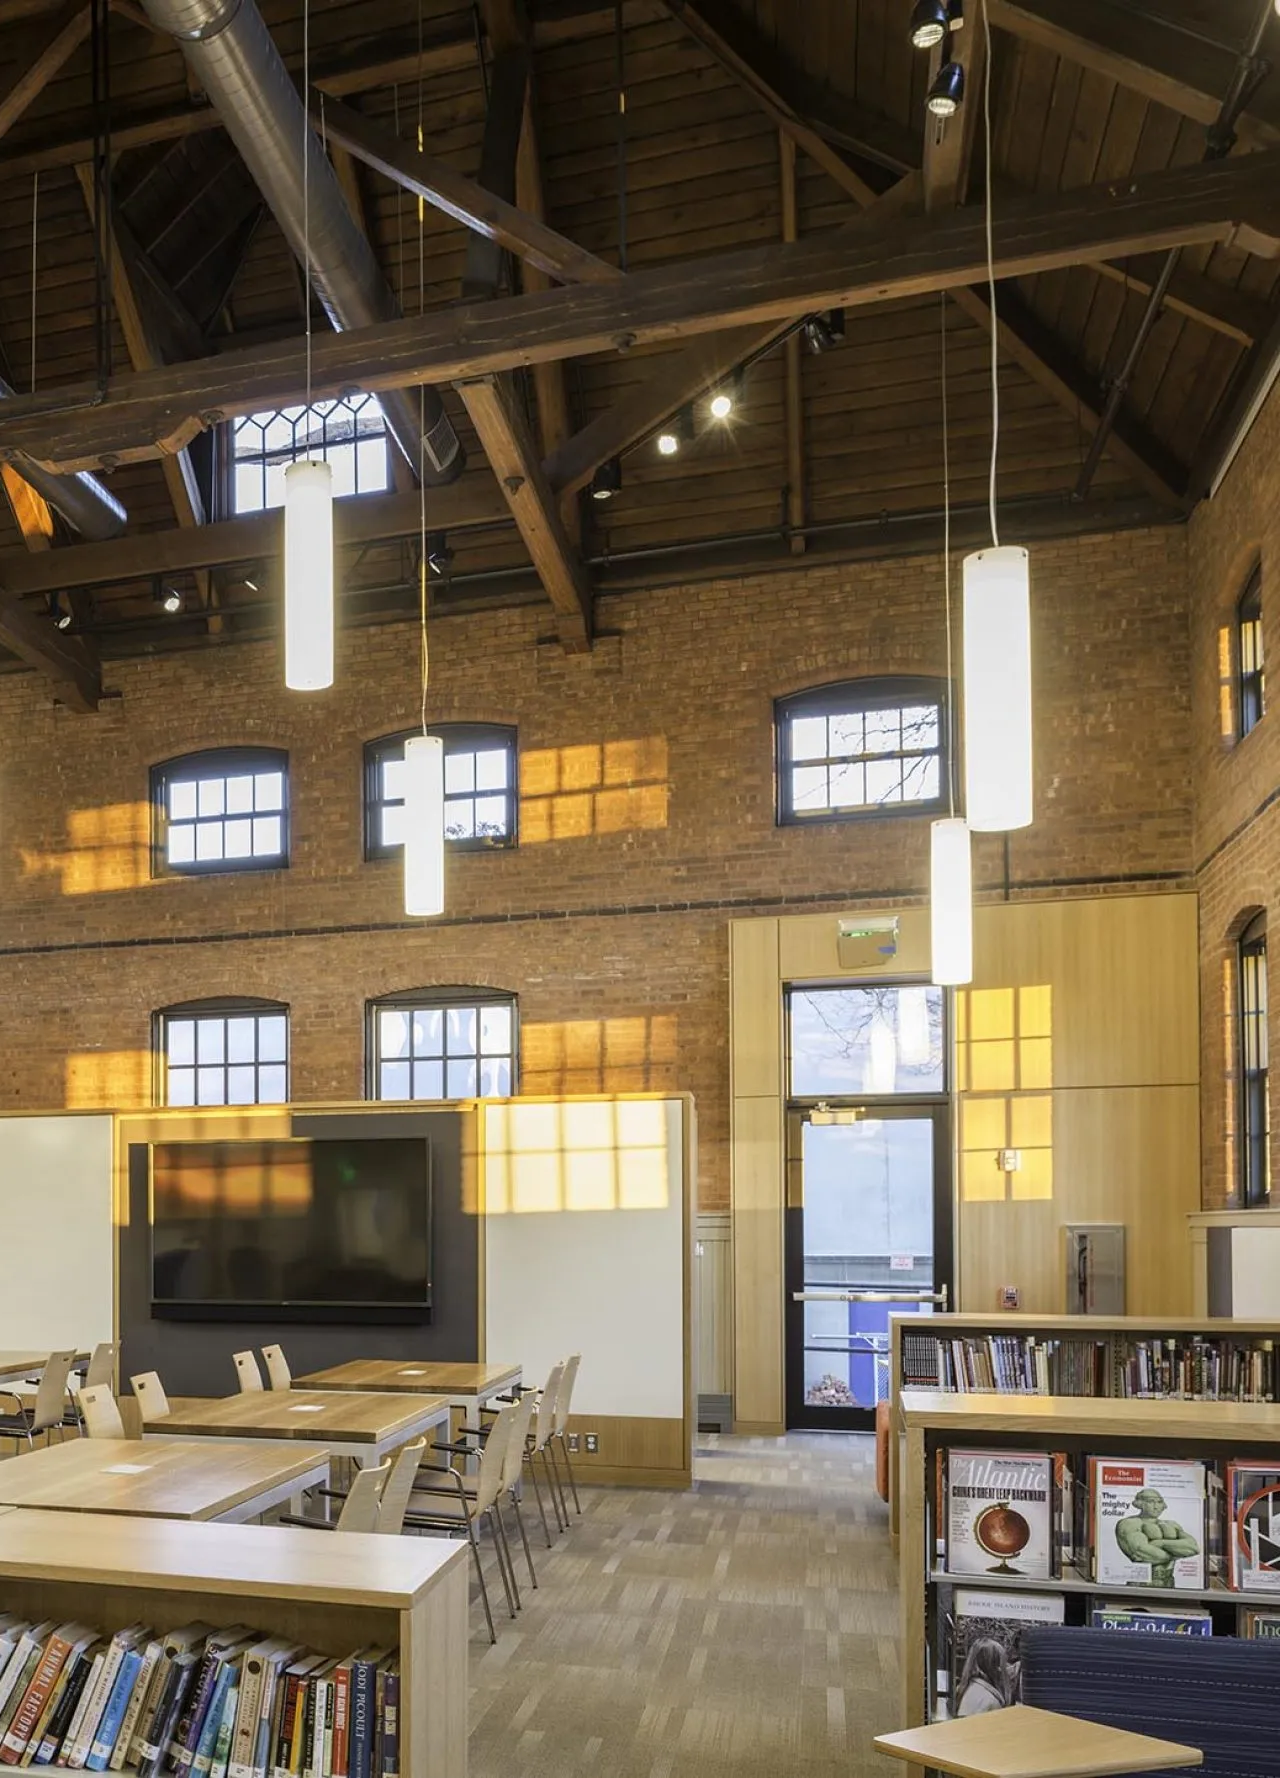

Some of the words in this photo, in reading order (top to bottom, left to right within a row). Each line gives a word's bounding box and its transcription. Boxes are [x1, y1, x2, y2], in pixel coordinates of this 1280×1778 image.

[954, 1459, 1047, 1489] Atlantic
[952, 1486, 976, 1498] CHINA'S
[996, 1488, 1010, 1500] LEAP
[1011, 1489, 1046, 1502] BACKWARD
[1102, 1500, 1130, 1509] mighty
[1102, 1508, 1125, 1516] dollar
[38, 1648, 62, 1688] ANIMAL
[358, 1664, 368, 1689] JODI
[14, 1690, 44, 1738] FACTORY
[355, 1693, 366, 1740] PICOULT
